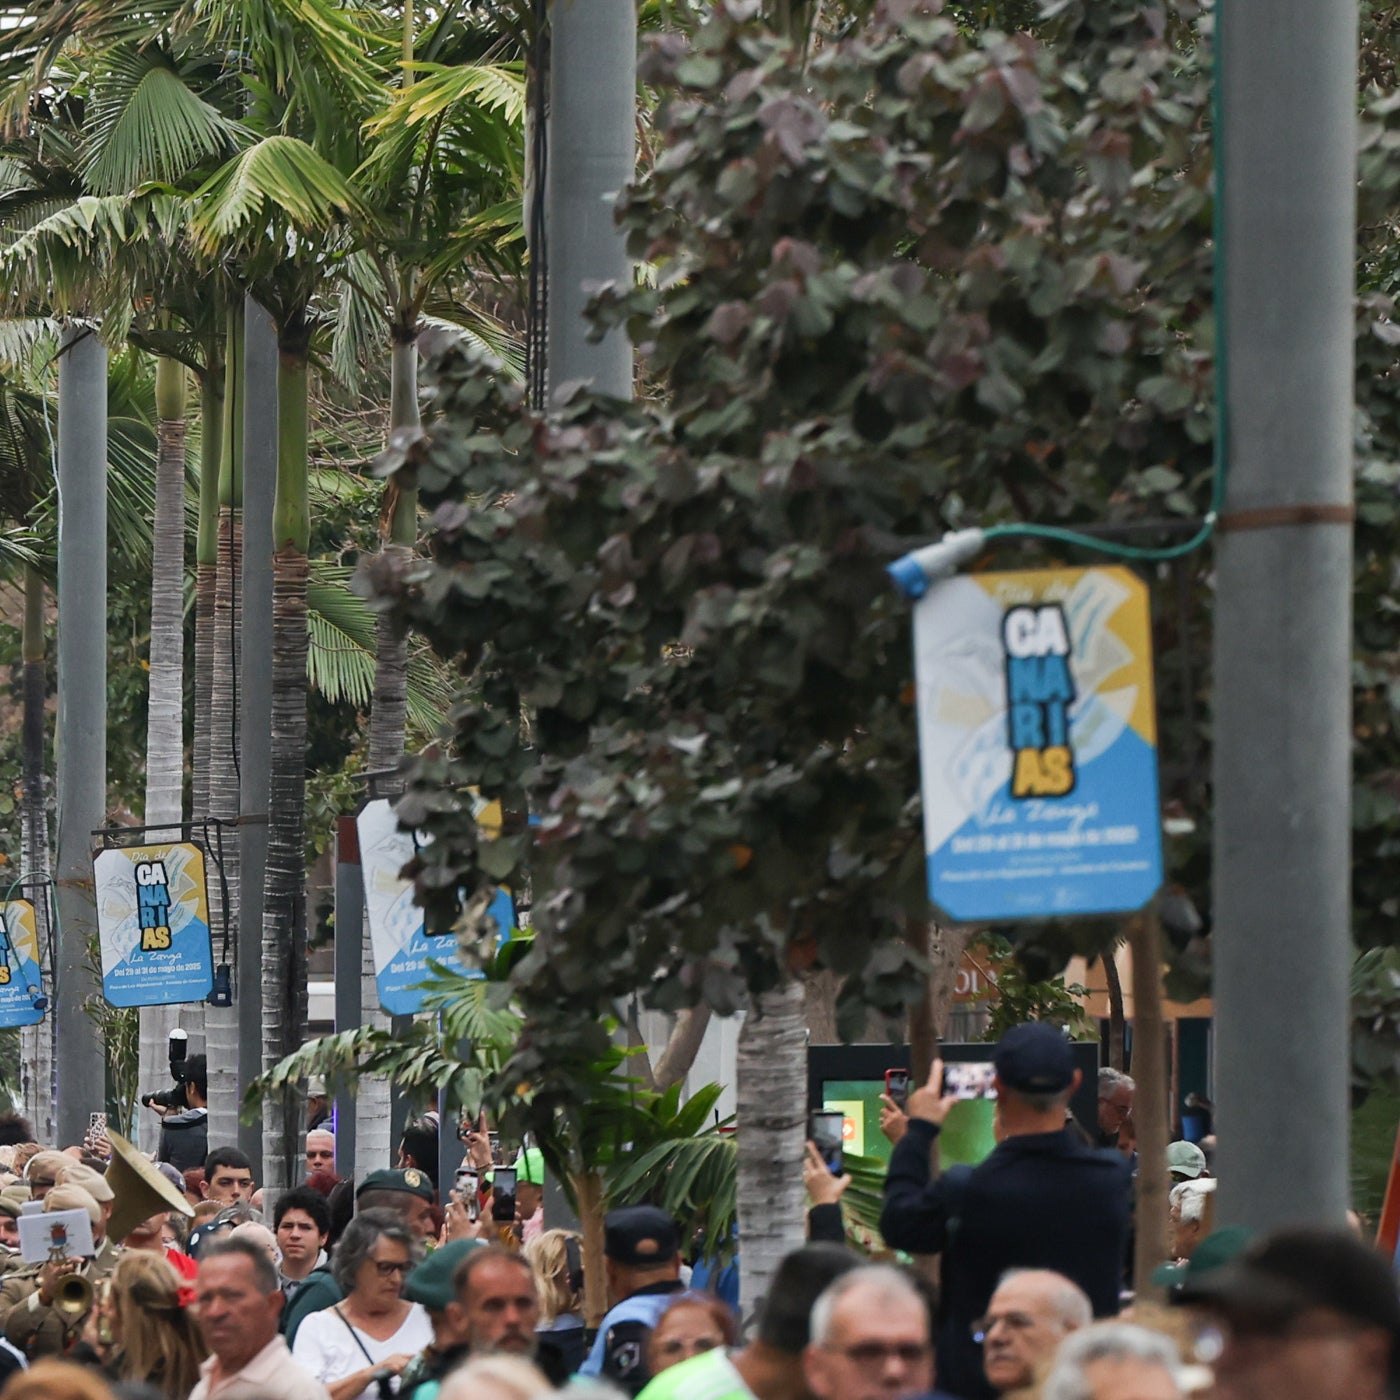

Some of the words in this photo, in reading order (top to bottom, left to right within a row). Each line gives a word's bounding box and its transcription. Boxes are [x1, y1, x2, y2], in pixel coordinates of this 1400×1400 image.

[1004, 605, 1068, 658] CA
[1007, 656, 1073, 701] NA
[1010, 702, 1067, 748] RI
[1013, 748, 1074, 797] AS
[137, 862, 166, 886] CA
[140, 884, 168, 906] NA
[141, 905, 166, 928] RI
[142, 926, 170, 950] AS
[130, 952, 144, 964] La
